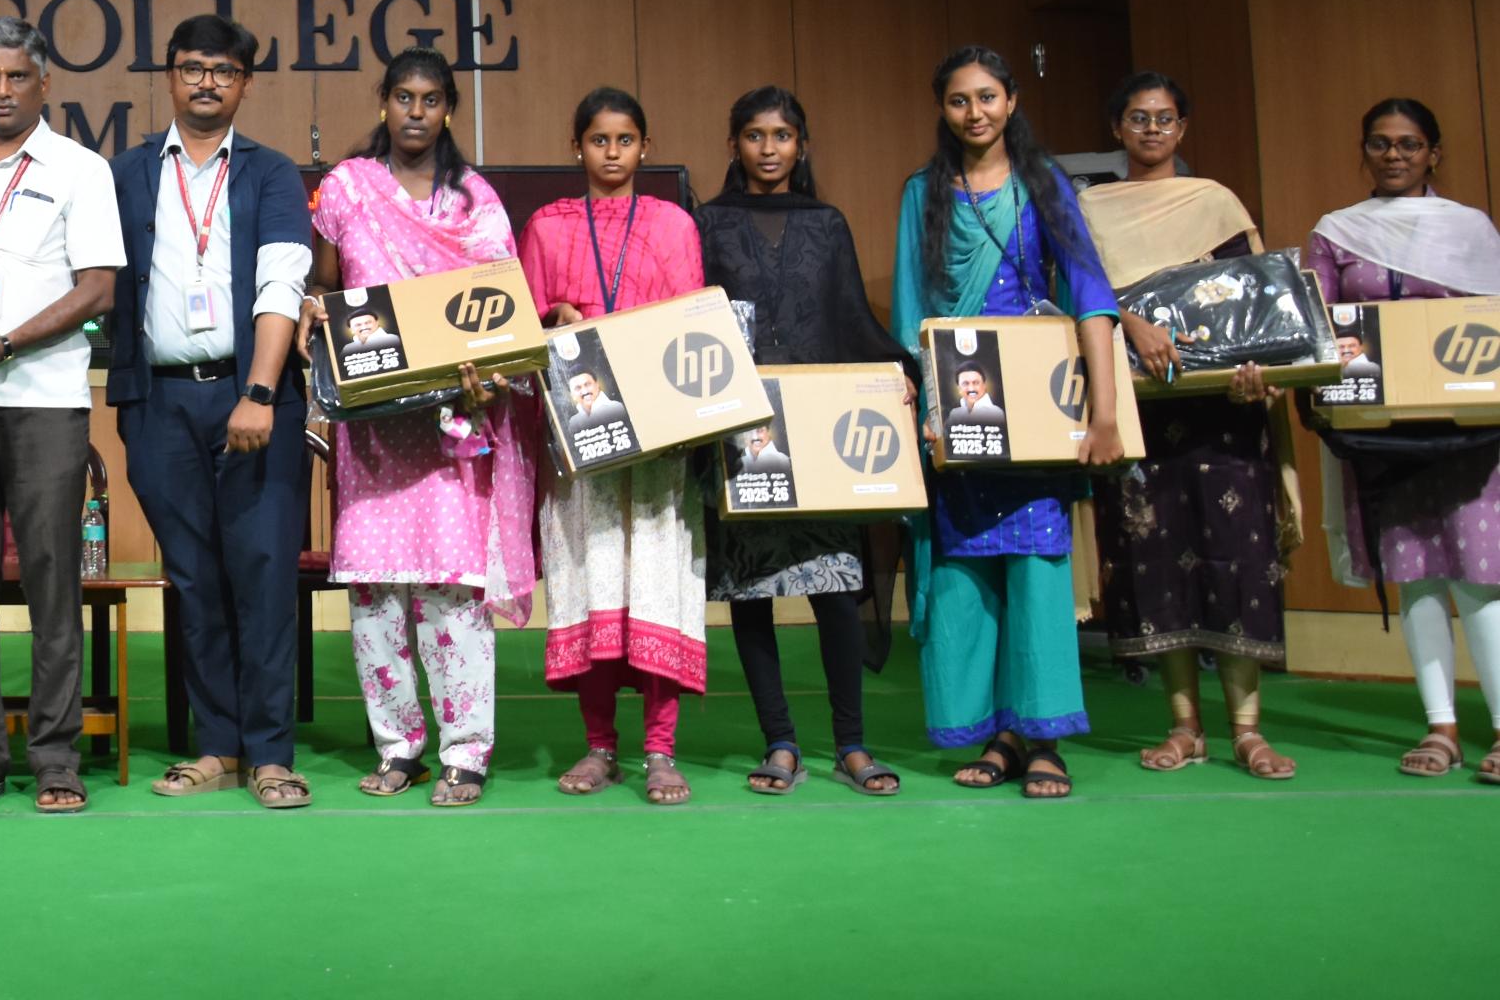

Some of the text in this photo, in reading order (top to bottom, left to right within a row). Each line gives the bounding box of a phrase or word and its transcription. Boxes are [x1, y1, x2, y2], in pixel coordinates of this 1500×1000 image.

[455, 287, 506, 333] hp
[675, 332, 723, 398] hp
[1442, 323, 1500, 375] hp
[1322, 388, 1376, 402] 2025-26
[579, 434, 632, 462] 2025-26
[843, 408, 892, 474] hp
[952, 439, 1003, 455] 2025-26
[738, 486, 789, 503] 2025-26
